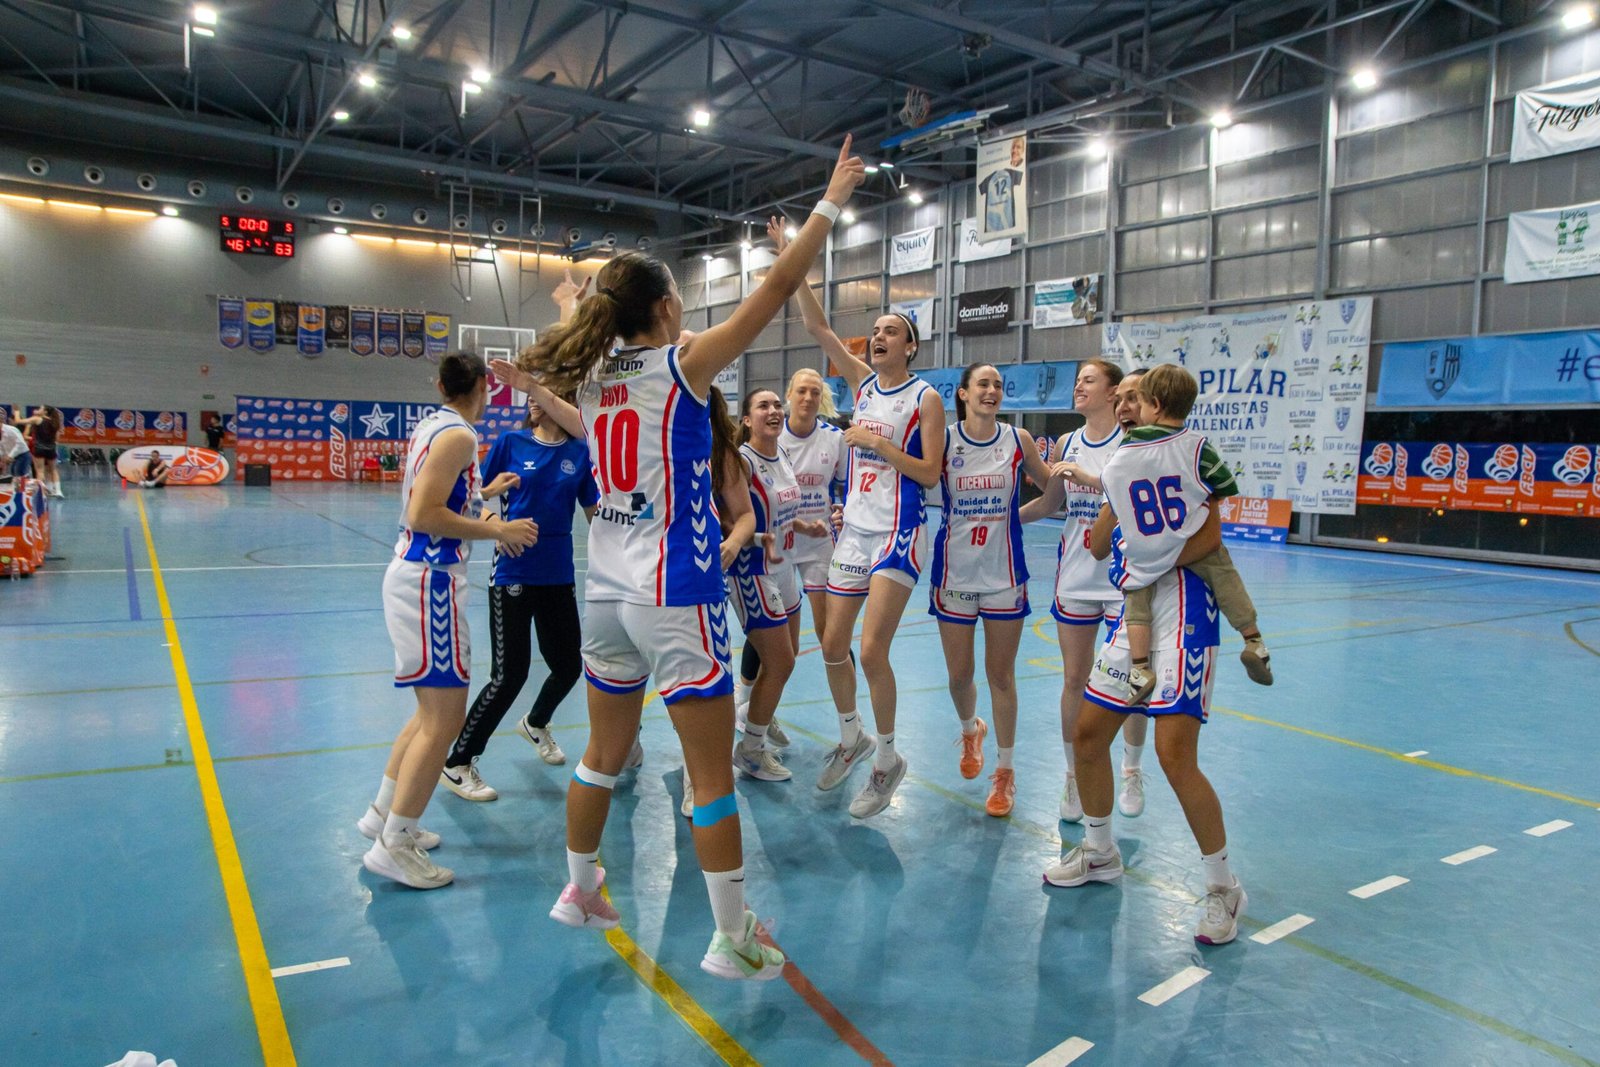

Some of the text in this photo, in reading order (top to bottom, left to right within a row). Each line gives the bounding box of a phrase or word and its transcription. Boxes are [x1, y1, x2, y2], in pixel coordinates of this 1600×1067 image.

[226, 239, 244, 252] 46
[274, 243, 293, 256] 63
[896, 232, 929, 253] equity
[959, 302, 1009, 318] dormitienda
[1199, 368, 1287, 397] PILAR
[594, 409, 640, 495] 10
[860, 472, 877, 492] 12
[957, 476, 1004, 490] LUCENTUM
[958, 496, 1002, 506] Unidad de
[1129, 476, 1187, 536] 86
[1242, 500, 1269, 511] LIGA
[783, 530, 794, 550] 18
[971, 525, 988, 546] 19
